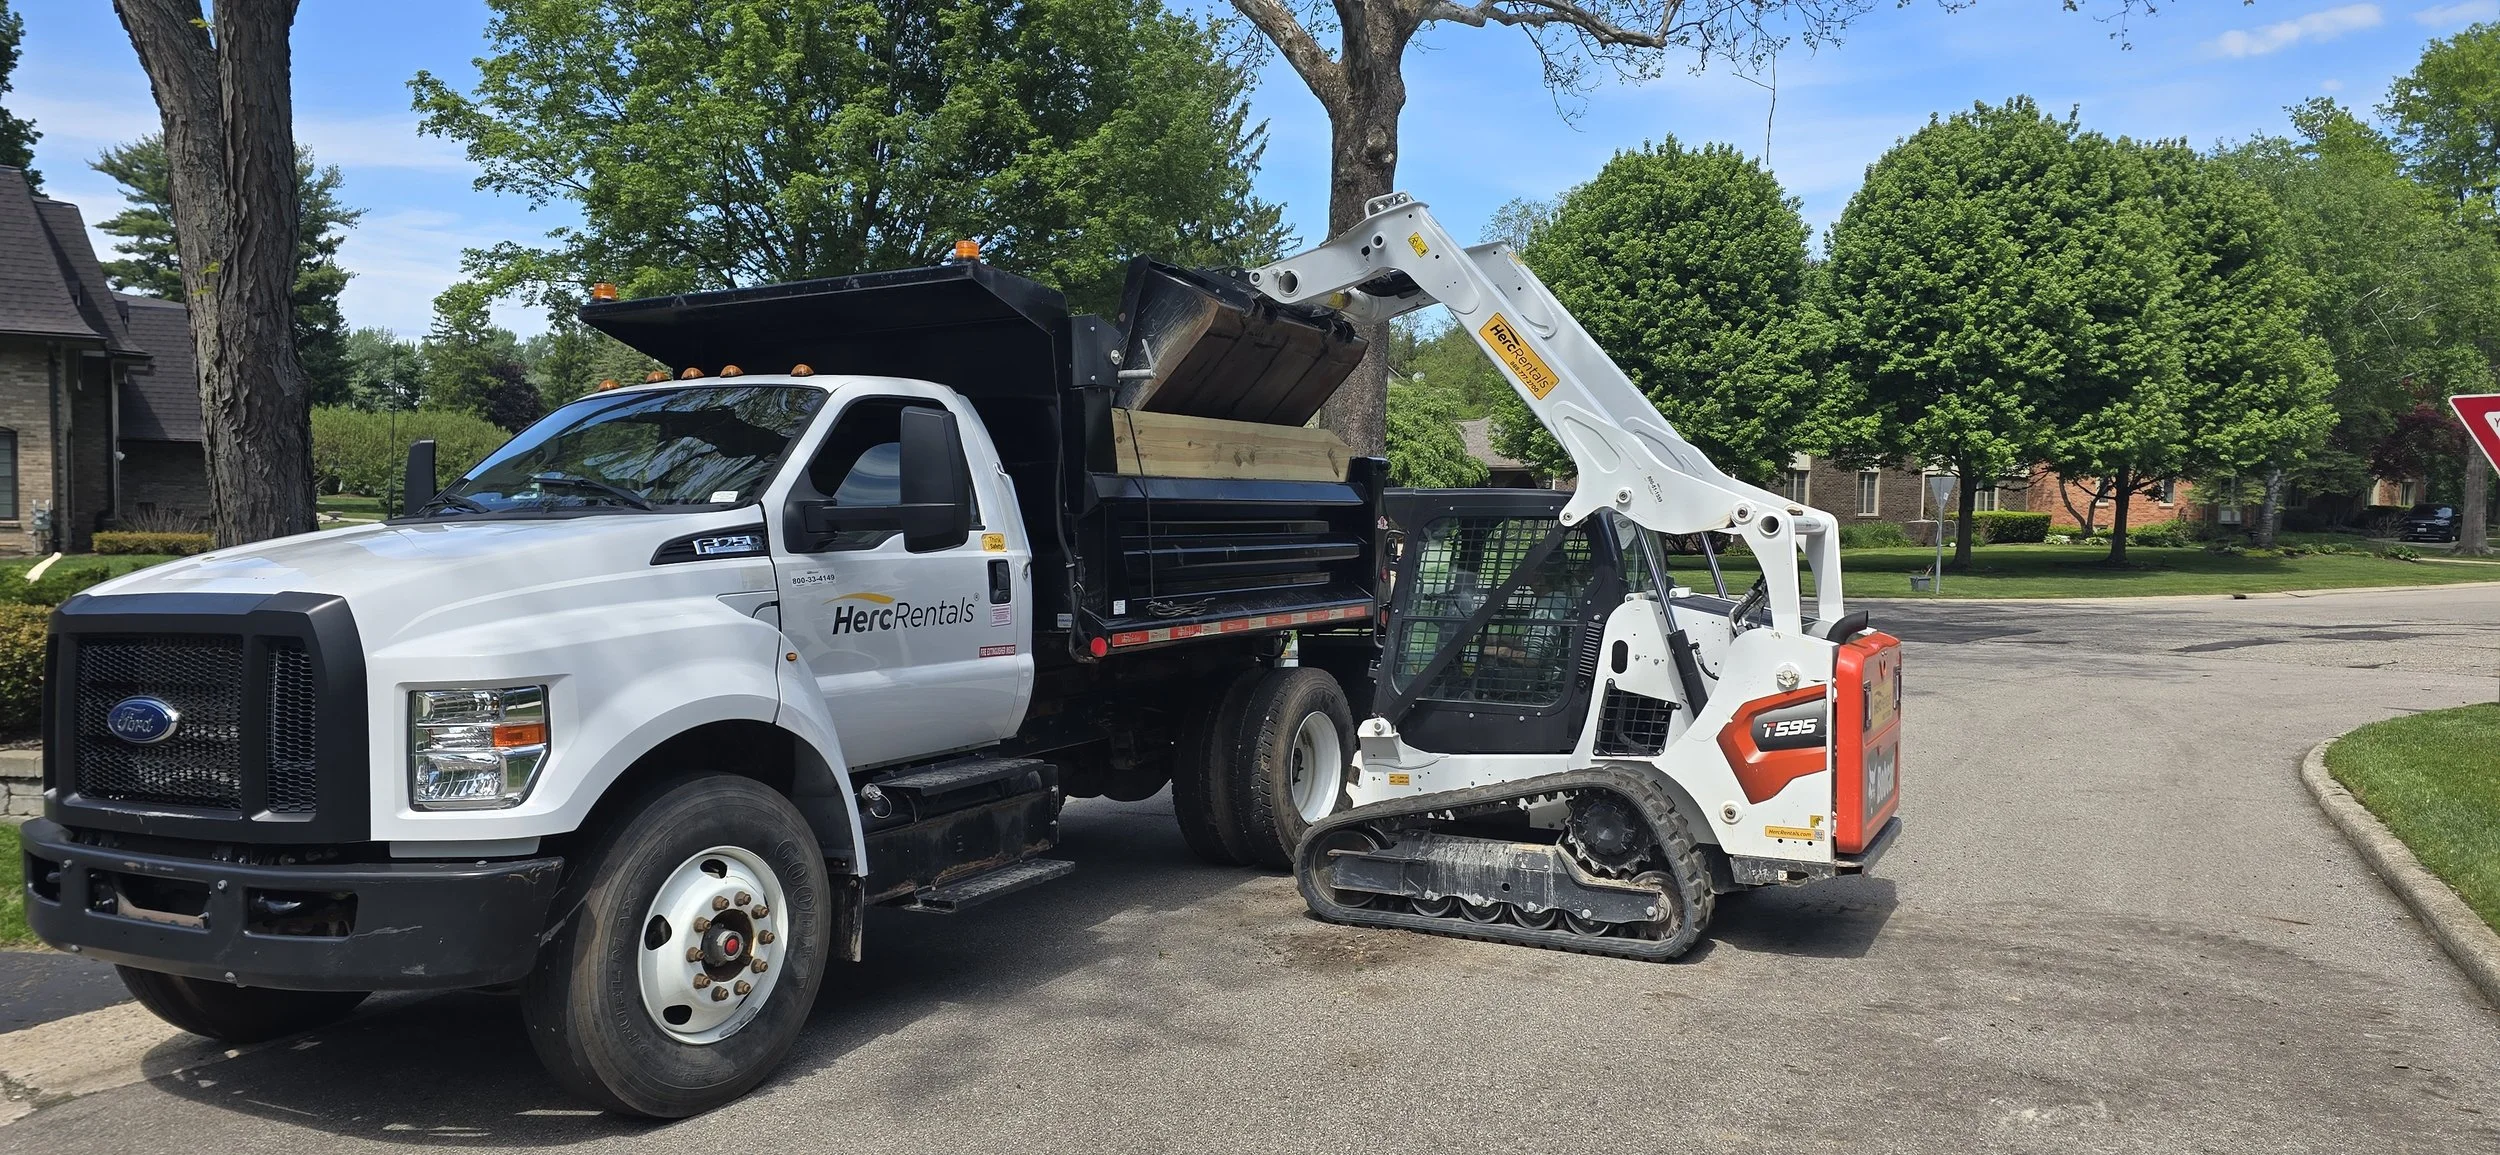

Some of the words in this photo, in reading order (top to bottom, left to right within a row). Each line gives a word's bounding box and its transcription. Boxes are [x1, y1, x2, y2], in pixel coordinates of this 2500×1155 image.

[1489, 323, 1549, 389] HercRentals
[792, 574, 835, 585] 800-33-4149
[832, 596, 975, 635] HercRentals
[117, 706, 155, 733] Ford
[1762, 718, 1818, 738] T595
[1768, 828, 1812, 838] HercRentals.com
